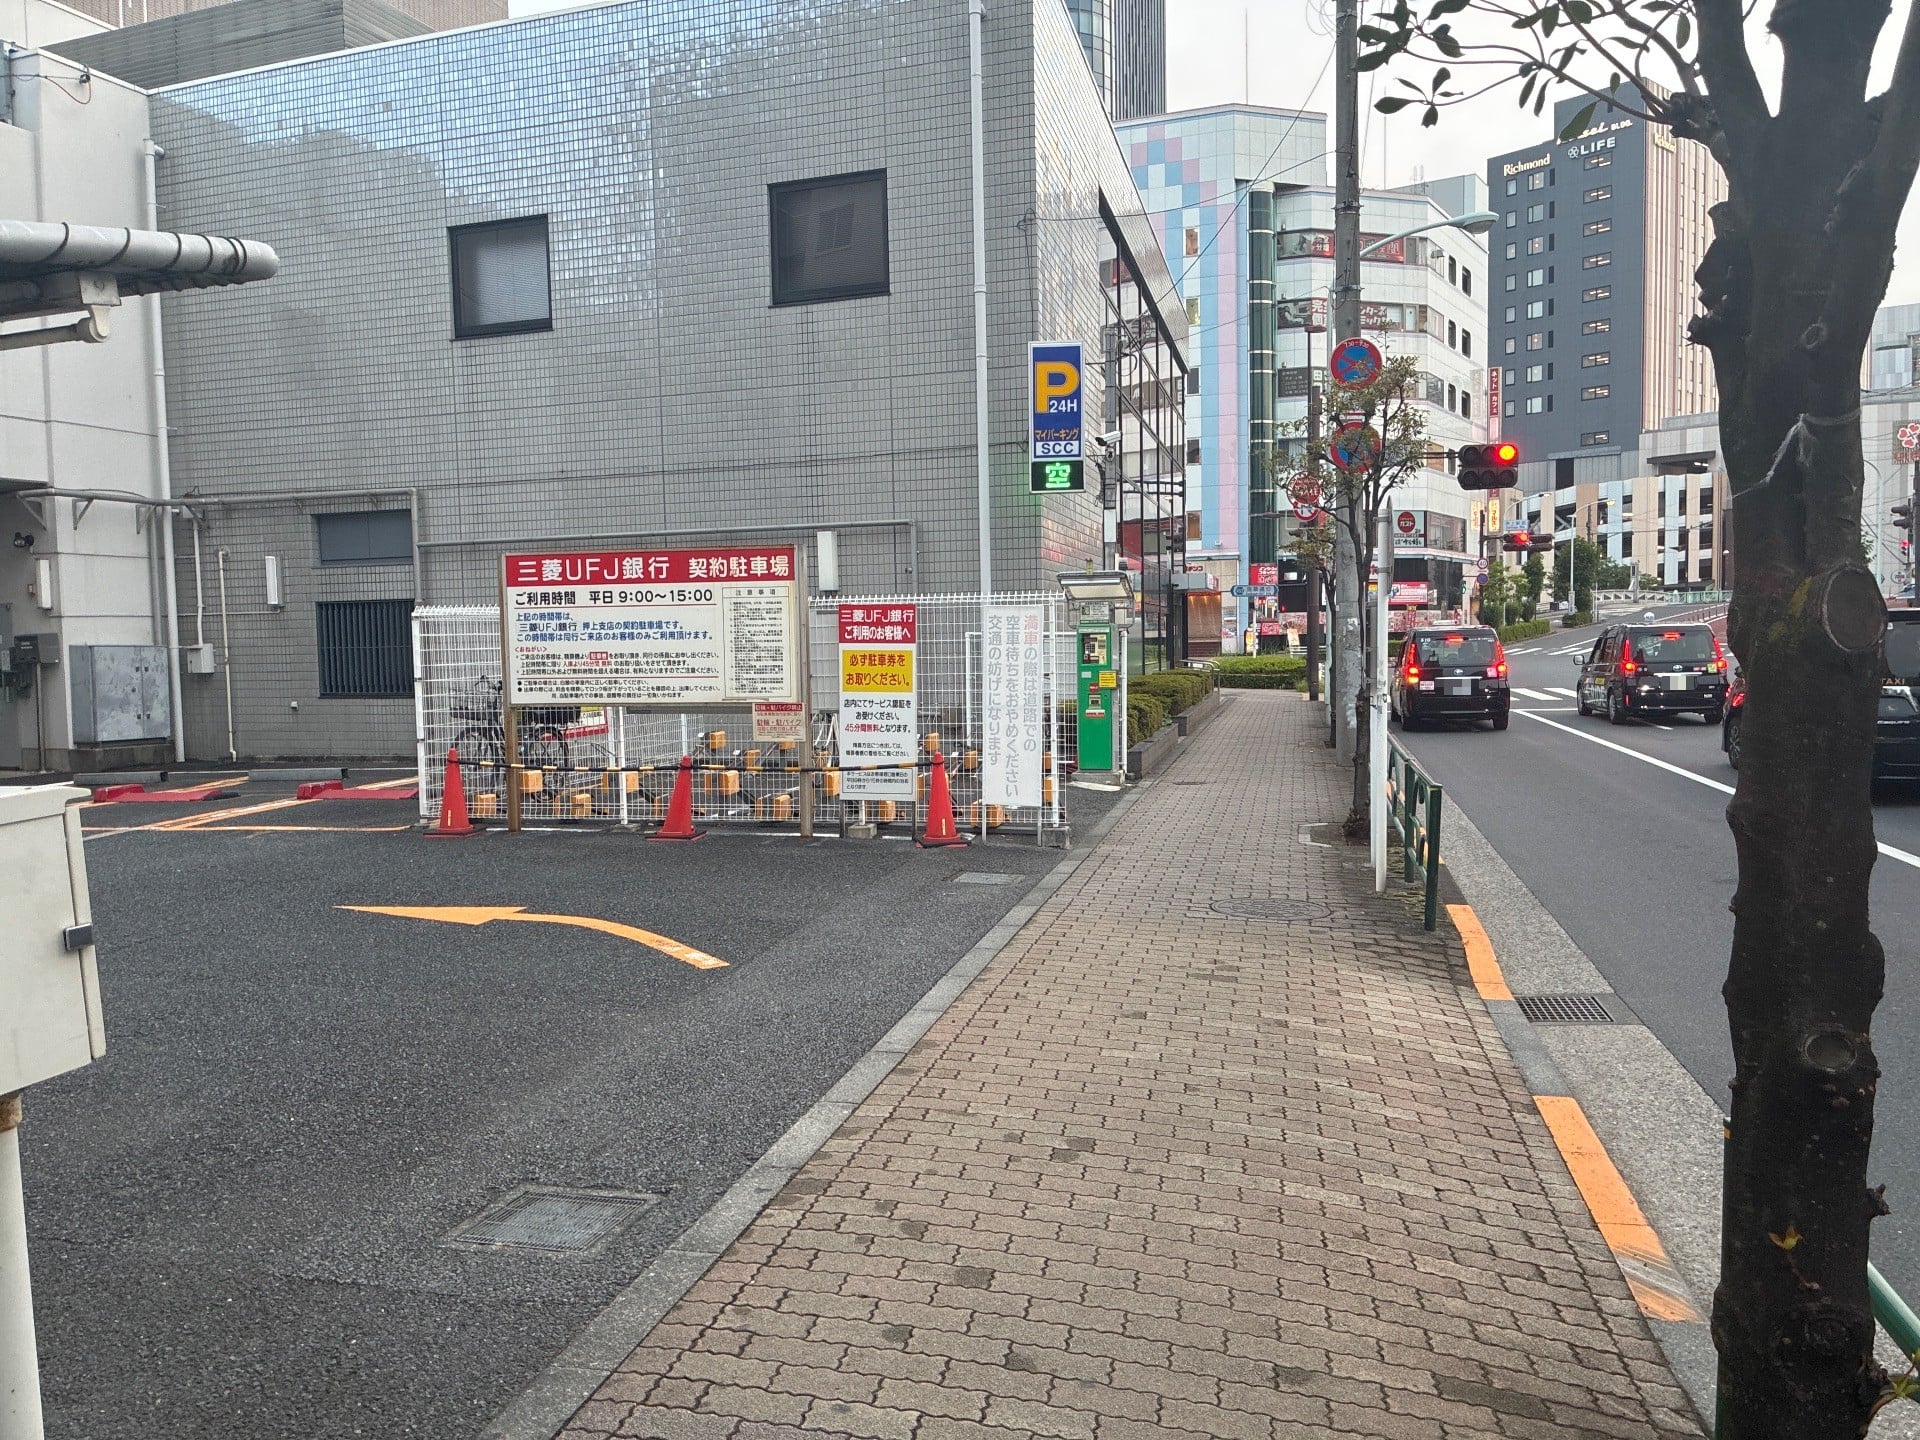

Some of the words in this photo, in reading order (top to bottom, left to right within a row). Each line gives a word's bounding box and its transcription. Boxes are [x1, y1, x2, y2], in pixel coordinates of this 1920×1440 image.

[1580, 137, 1616, 155] LIFE
[1503, 153, 1551, 177] Richmond
[1035, 361, 1080, 414] P
[1049, 399, 1078, 413] 24H
[1041, 442, 1074, 455] SCC
[1045, 462, 1071, 489] 空
[517, 557, 670, 582] 三菱UFJ銀行
[688, 555, 790, 579] 契約駐車場
[515, 590, 576, 606] ご利用時間
[589, 590, 613, 604] 平日
[840, 609, 915, 623] 三菱UFJ銀行
[519, 622, 578, 632] 三菱UFJ銀行
[844, 626, 911, 640] ご利用のお客様へ
[849, 654, 906, 667] 必ず駐車券を
[845, 672, 910, 686] お取りください。
[1023, 614, 1038, 752] 満車の際は道路での
[1881, 678, 1905, 686] TAXI
[987, 614, 1003, 766] 交通の妨げになります
[1005, 614, 1020, 798] 空車待ちをおやめください
[855, 711, 900, 721] お受けください。
